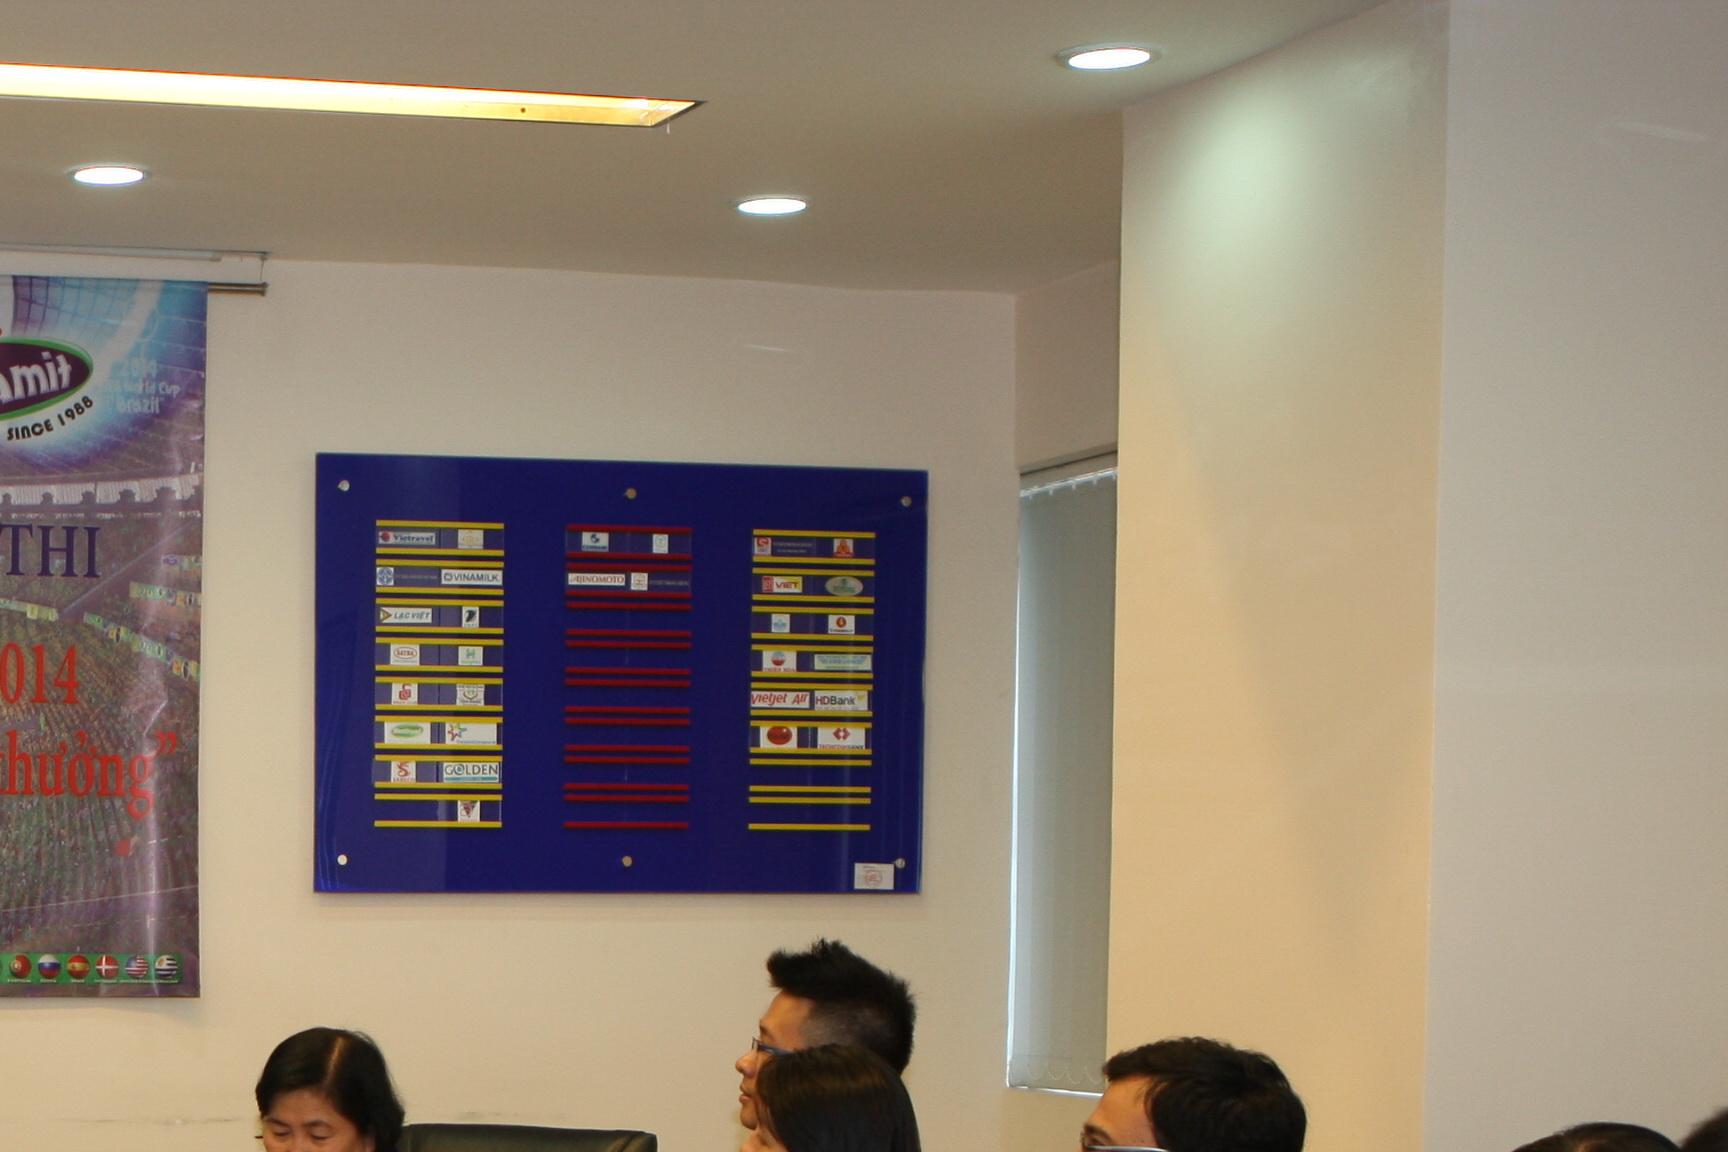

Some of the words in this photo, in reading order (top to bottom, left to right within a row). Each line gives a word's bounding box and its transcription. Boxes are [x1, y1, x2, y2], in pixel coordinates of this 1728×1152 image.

[7, 420, 54, 441] SINCE
[59, 396, 94, 427] 1988
[453, 573, 499, 582] VINAMILK
[569, 574, 625, 584] AJINOMOTO
[815, 695, 856, 706] HDBank
[444, 763, 499, 775] GOLDEN
